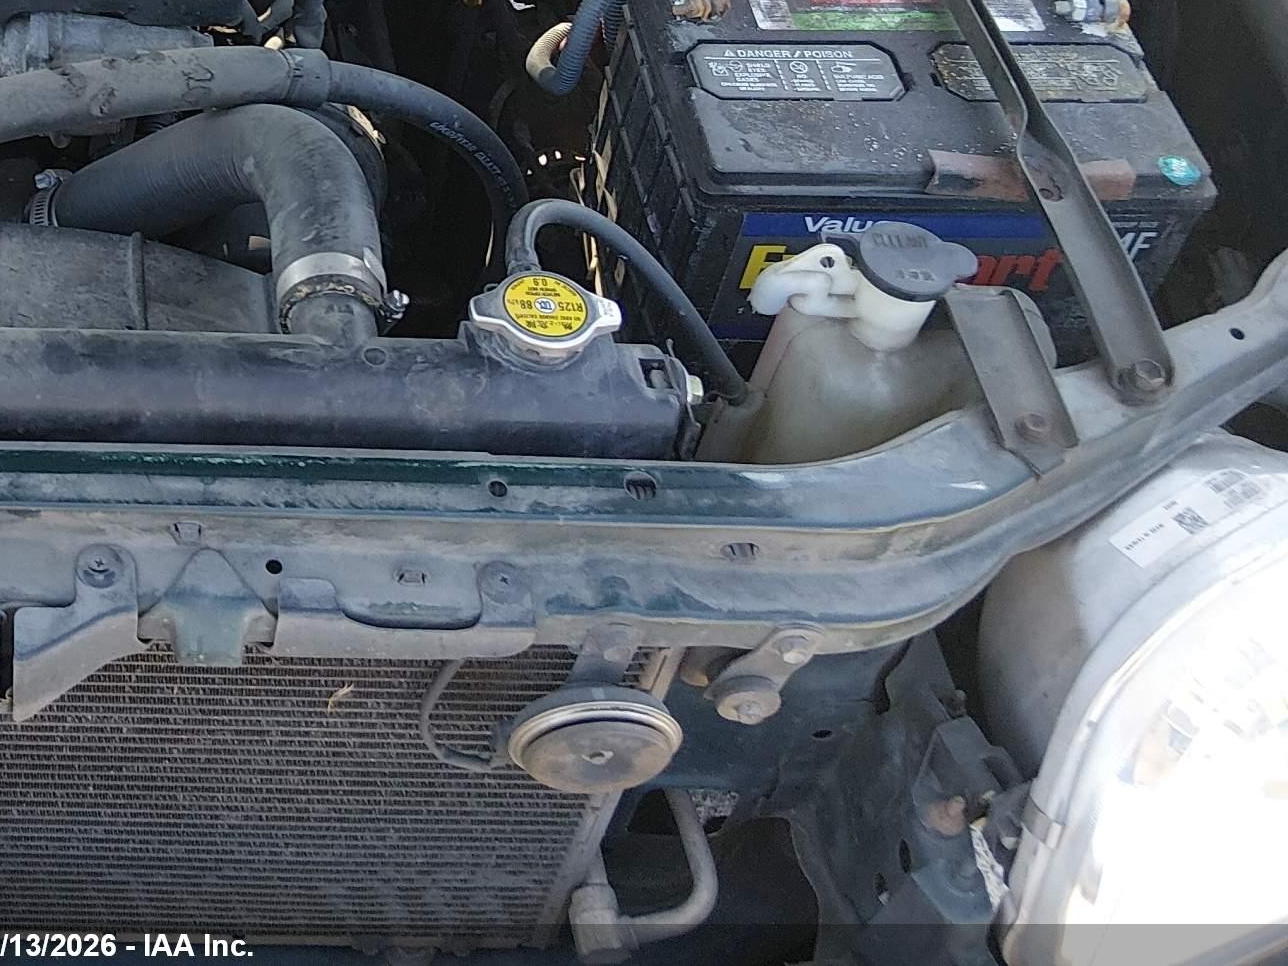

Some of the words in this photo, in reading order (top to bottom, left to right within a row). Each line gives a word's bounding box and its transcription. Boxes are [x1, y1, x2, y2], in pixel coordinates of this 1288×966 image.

[736, 48, 792, 59] DANGER
[803, 49, 853, 59] POISON
[804, 216, 874, 235] Valu
